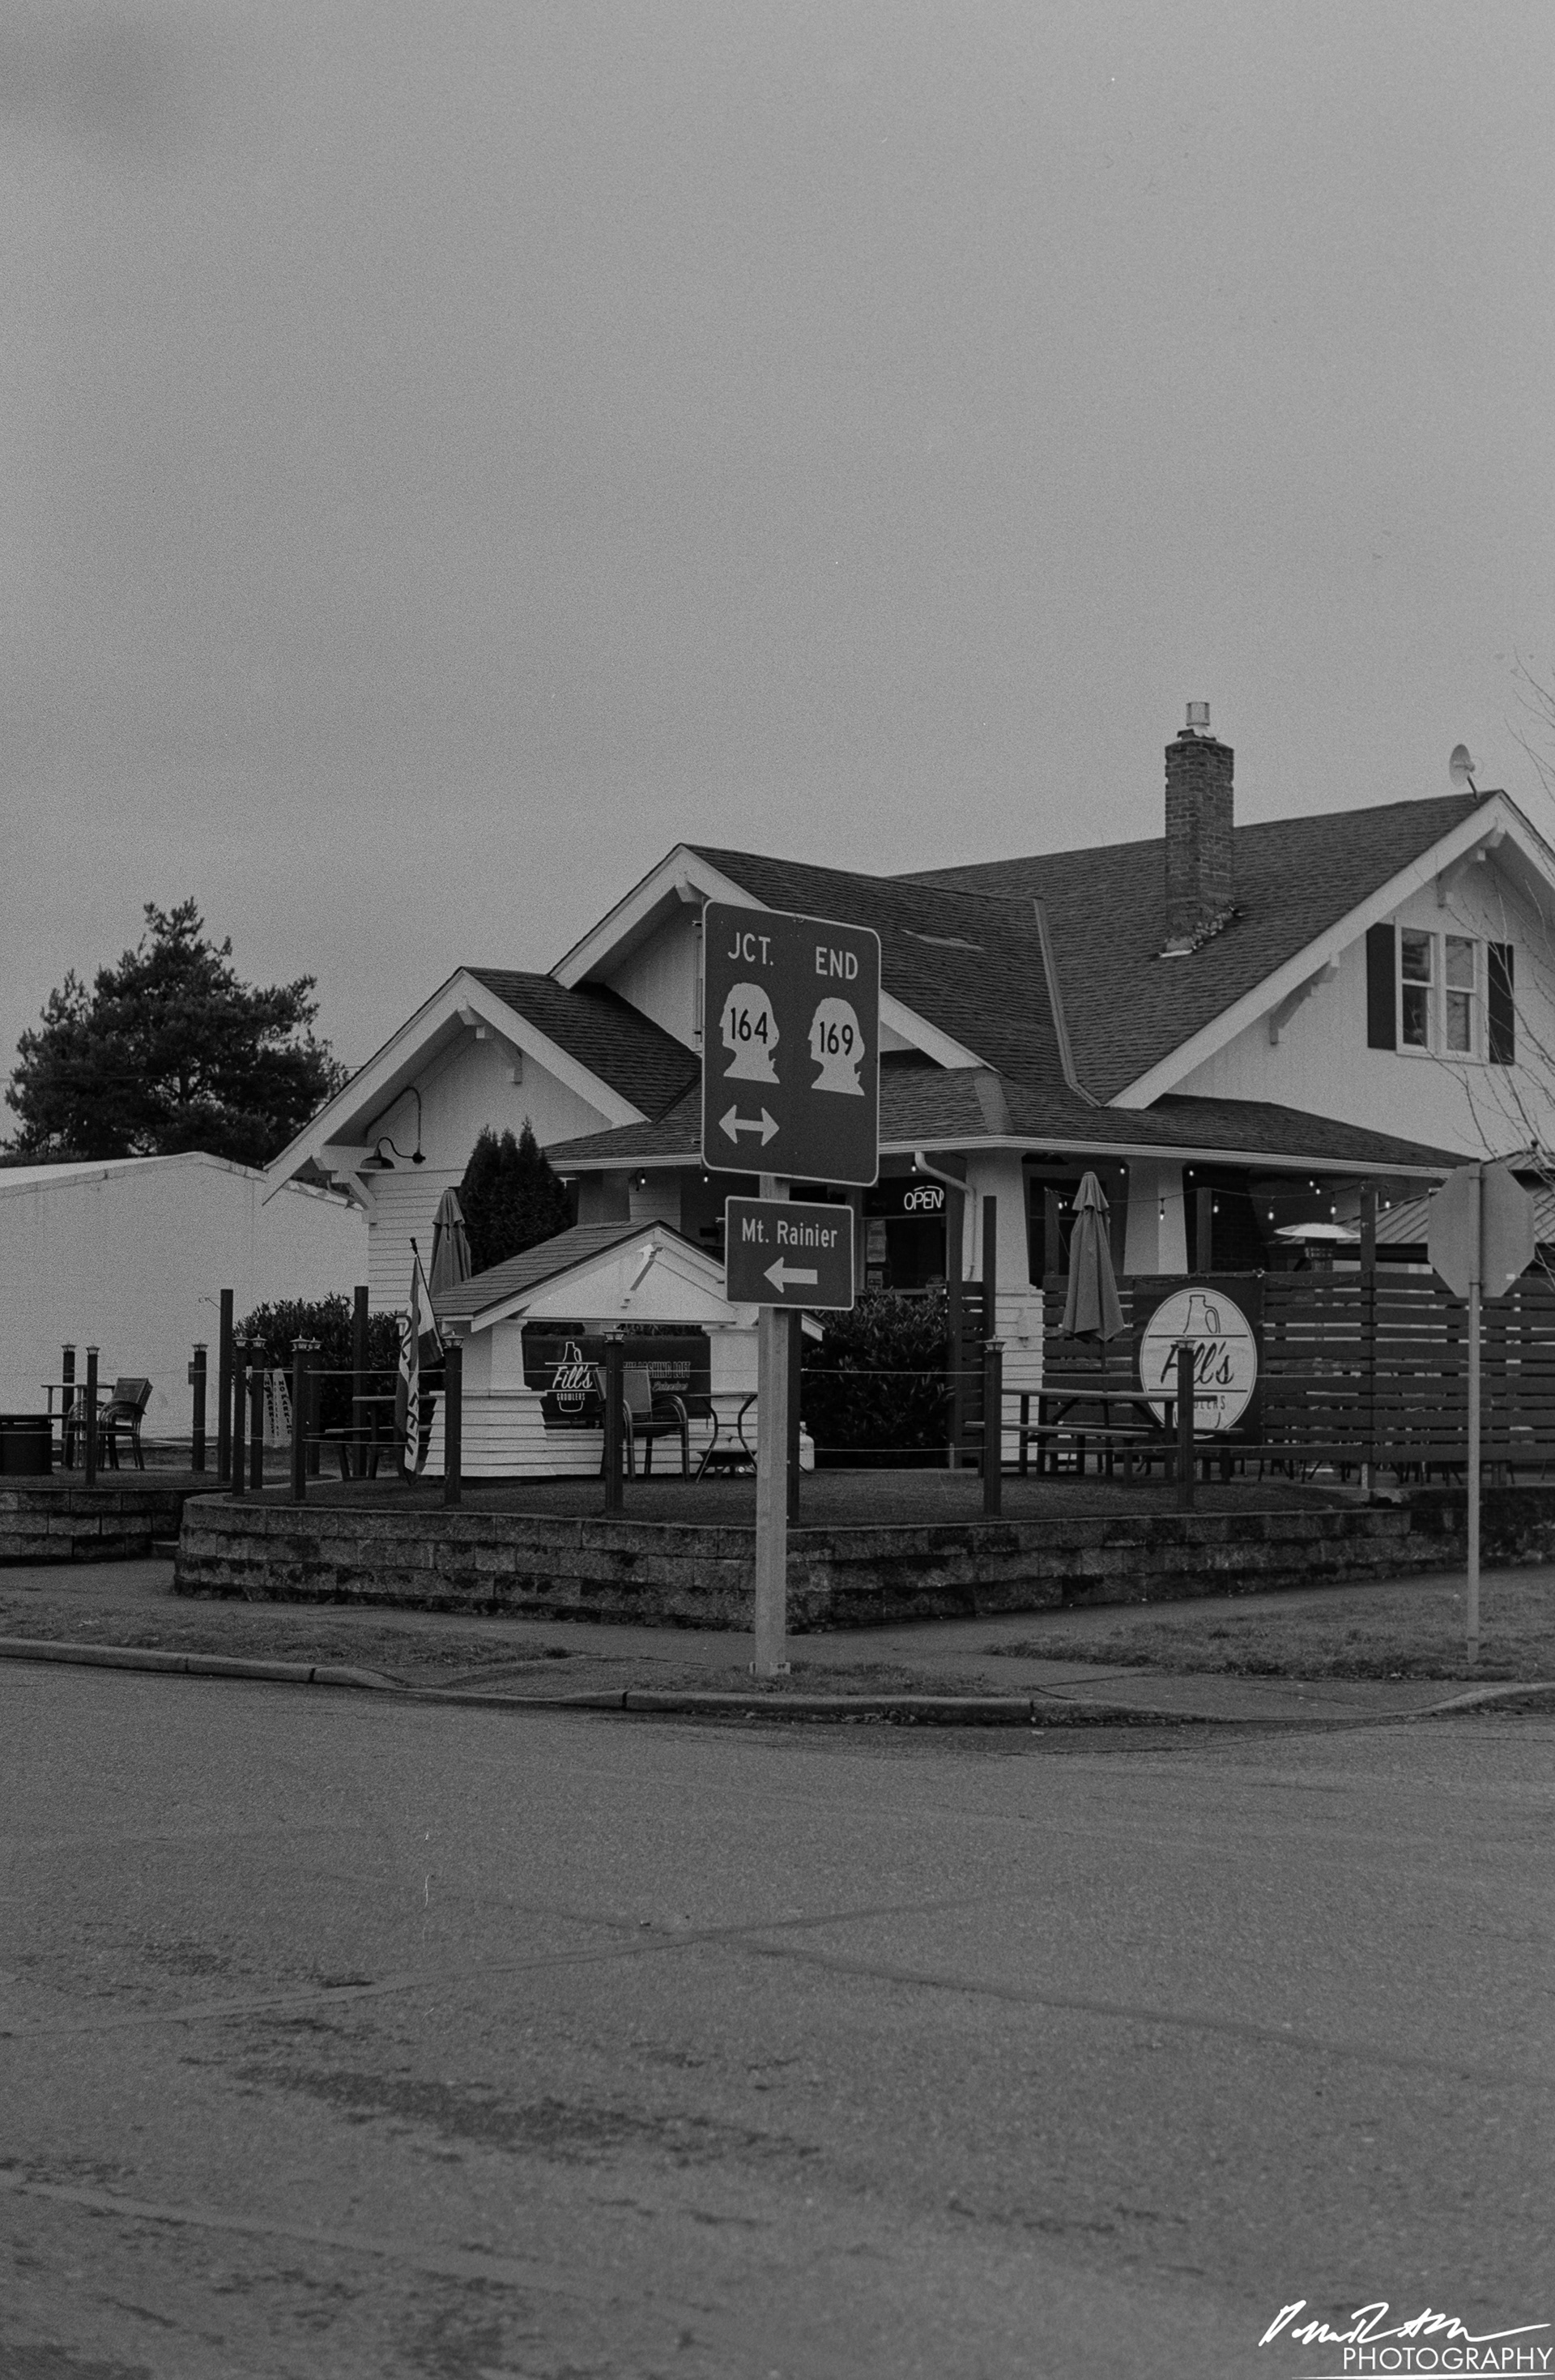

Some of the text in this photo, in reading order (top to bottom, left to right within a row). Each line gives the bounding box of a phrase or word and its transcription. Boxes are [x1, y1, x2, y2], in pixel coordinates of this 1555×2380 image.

[727, 932, 774, 966] JCT.
[815, 945, 858, 980] END
[731, 1007, 768, 1044] 164
[820, 1021, 854, 1056] 169
[904, 1191, 942, 1210] OPEN
[742, 1218, 837, 1248] Mt. Rainier
[279, 1380, 286, 1393] NO
[552, 1364, 593, 1389] Fill's
